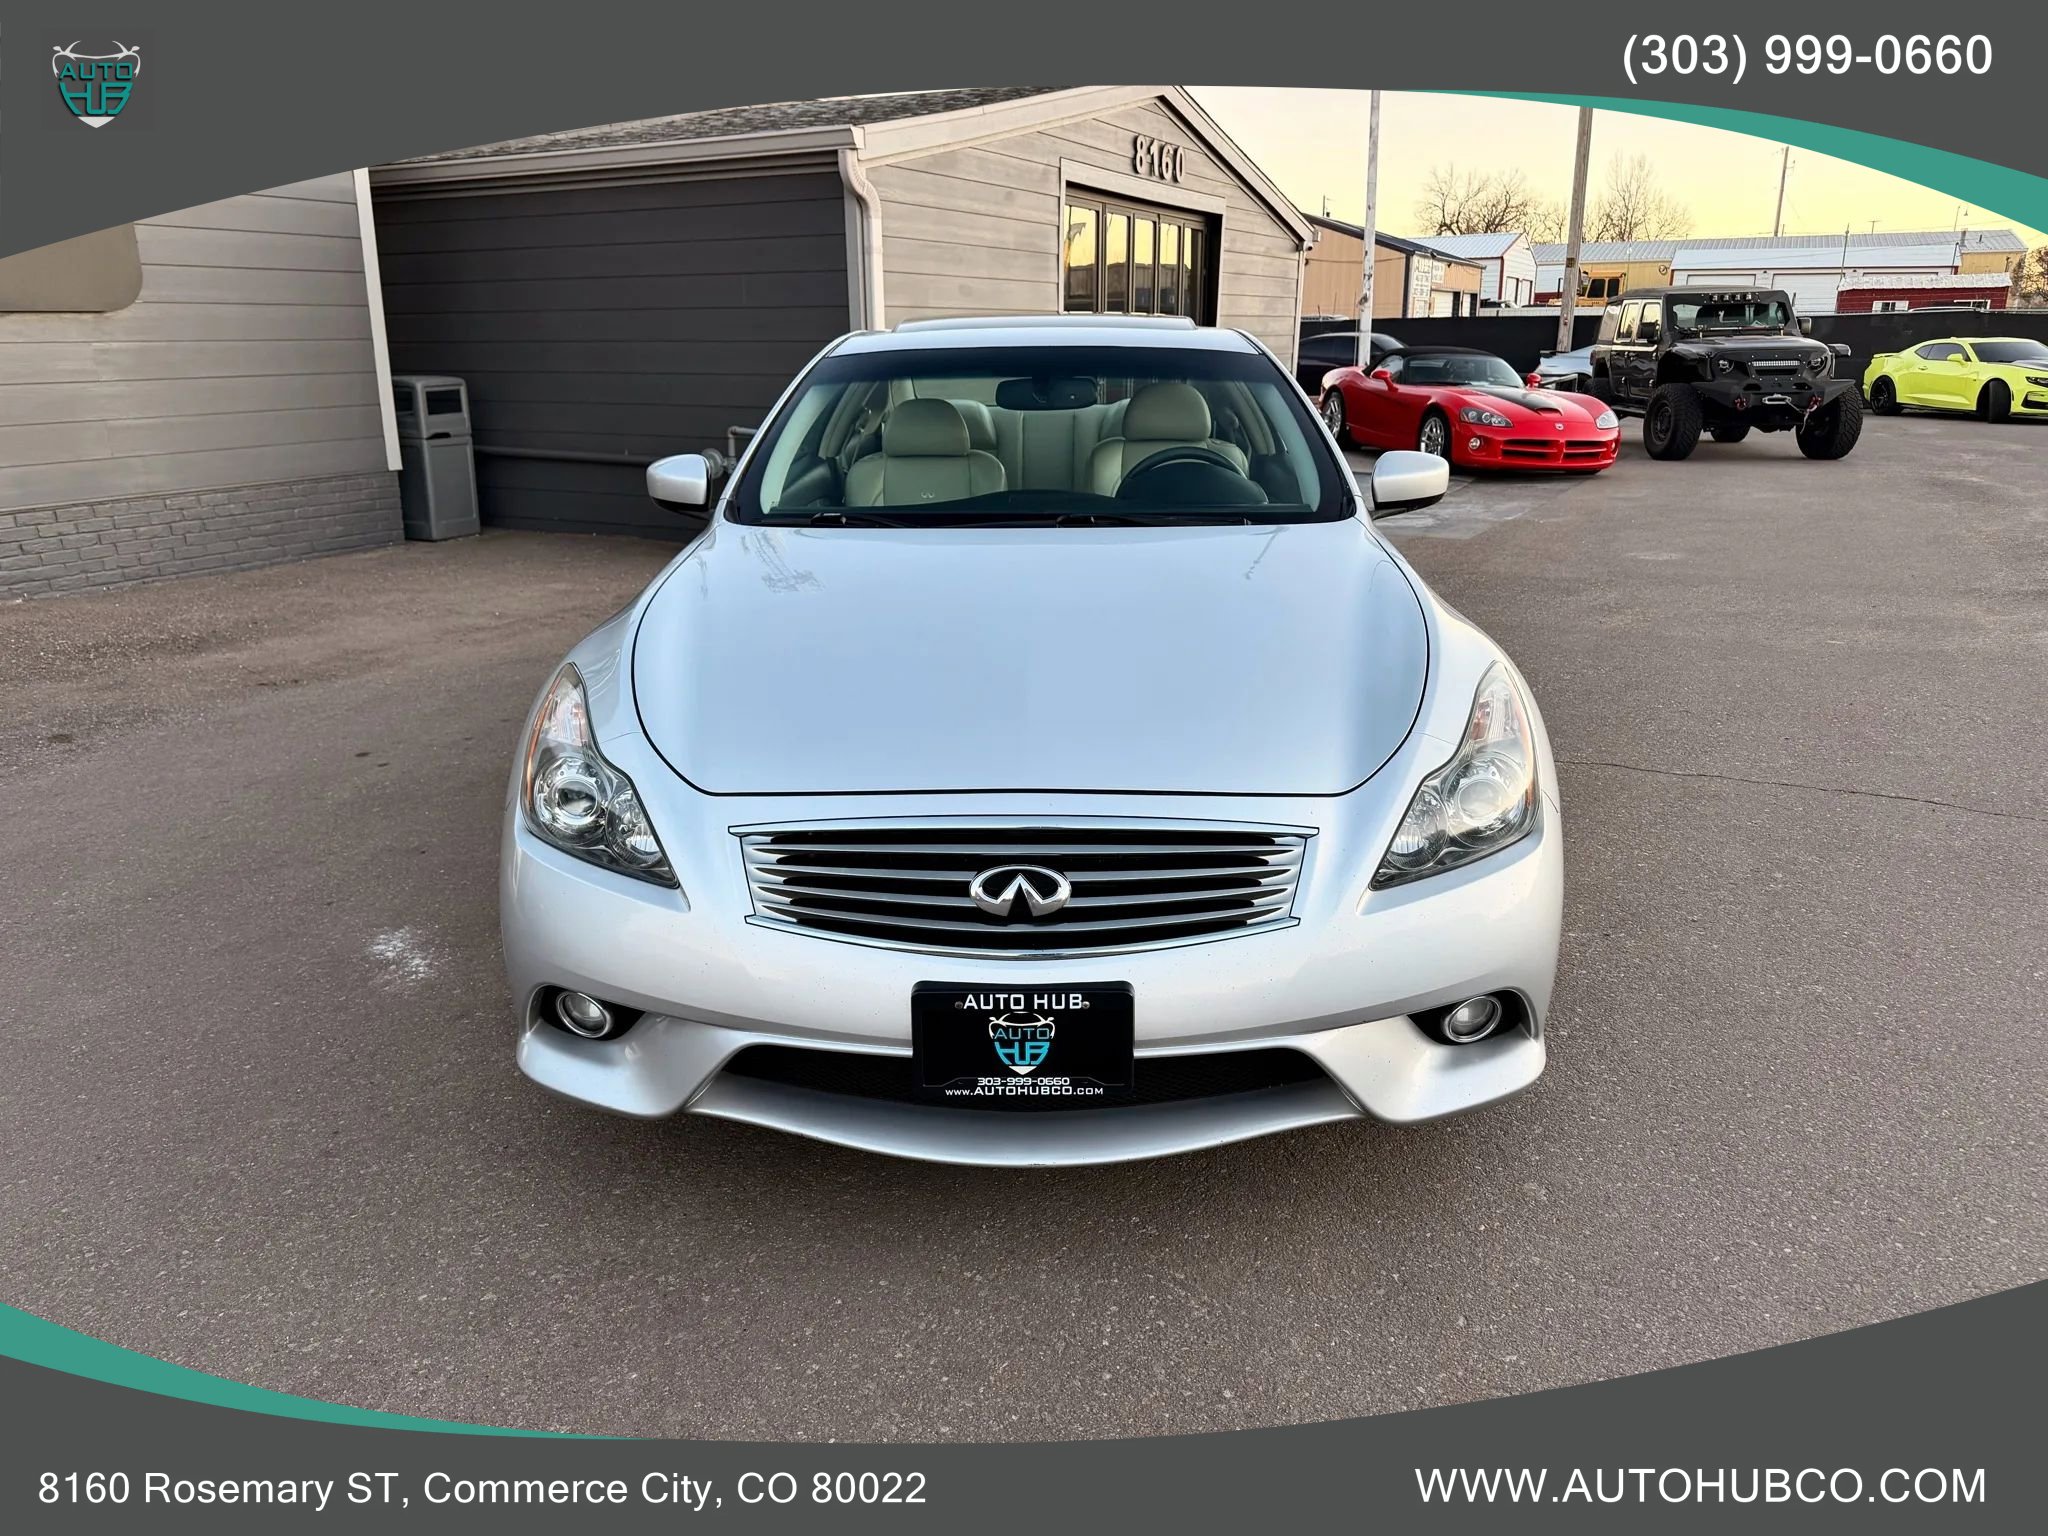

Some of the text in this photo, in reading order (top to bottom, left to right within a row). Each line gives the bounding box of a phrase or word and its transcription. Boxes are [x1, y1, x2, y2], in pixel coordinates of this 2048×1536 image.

[1134, 134, 1186, 183] 8160
[963, 993, 1082, 1010] AUTO HUB
[994, 1028, 1050, 1040] AUTO
[994, 1041, 1050, 1066] HUB
[977, 1077, 1070, 1086] 303-999-0660
